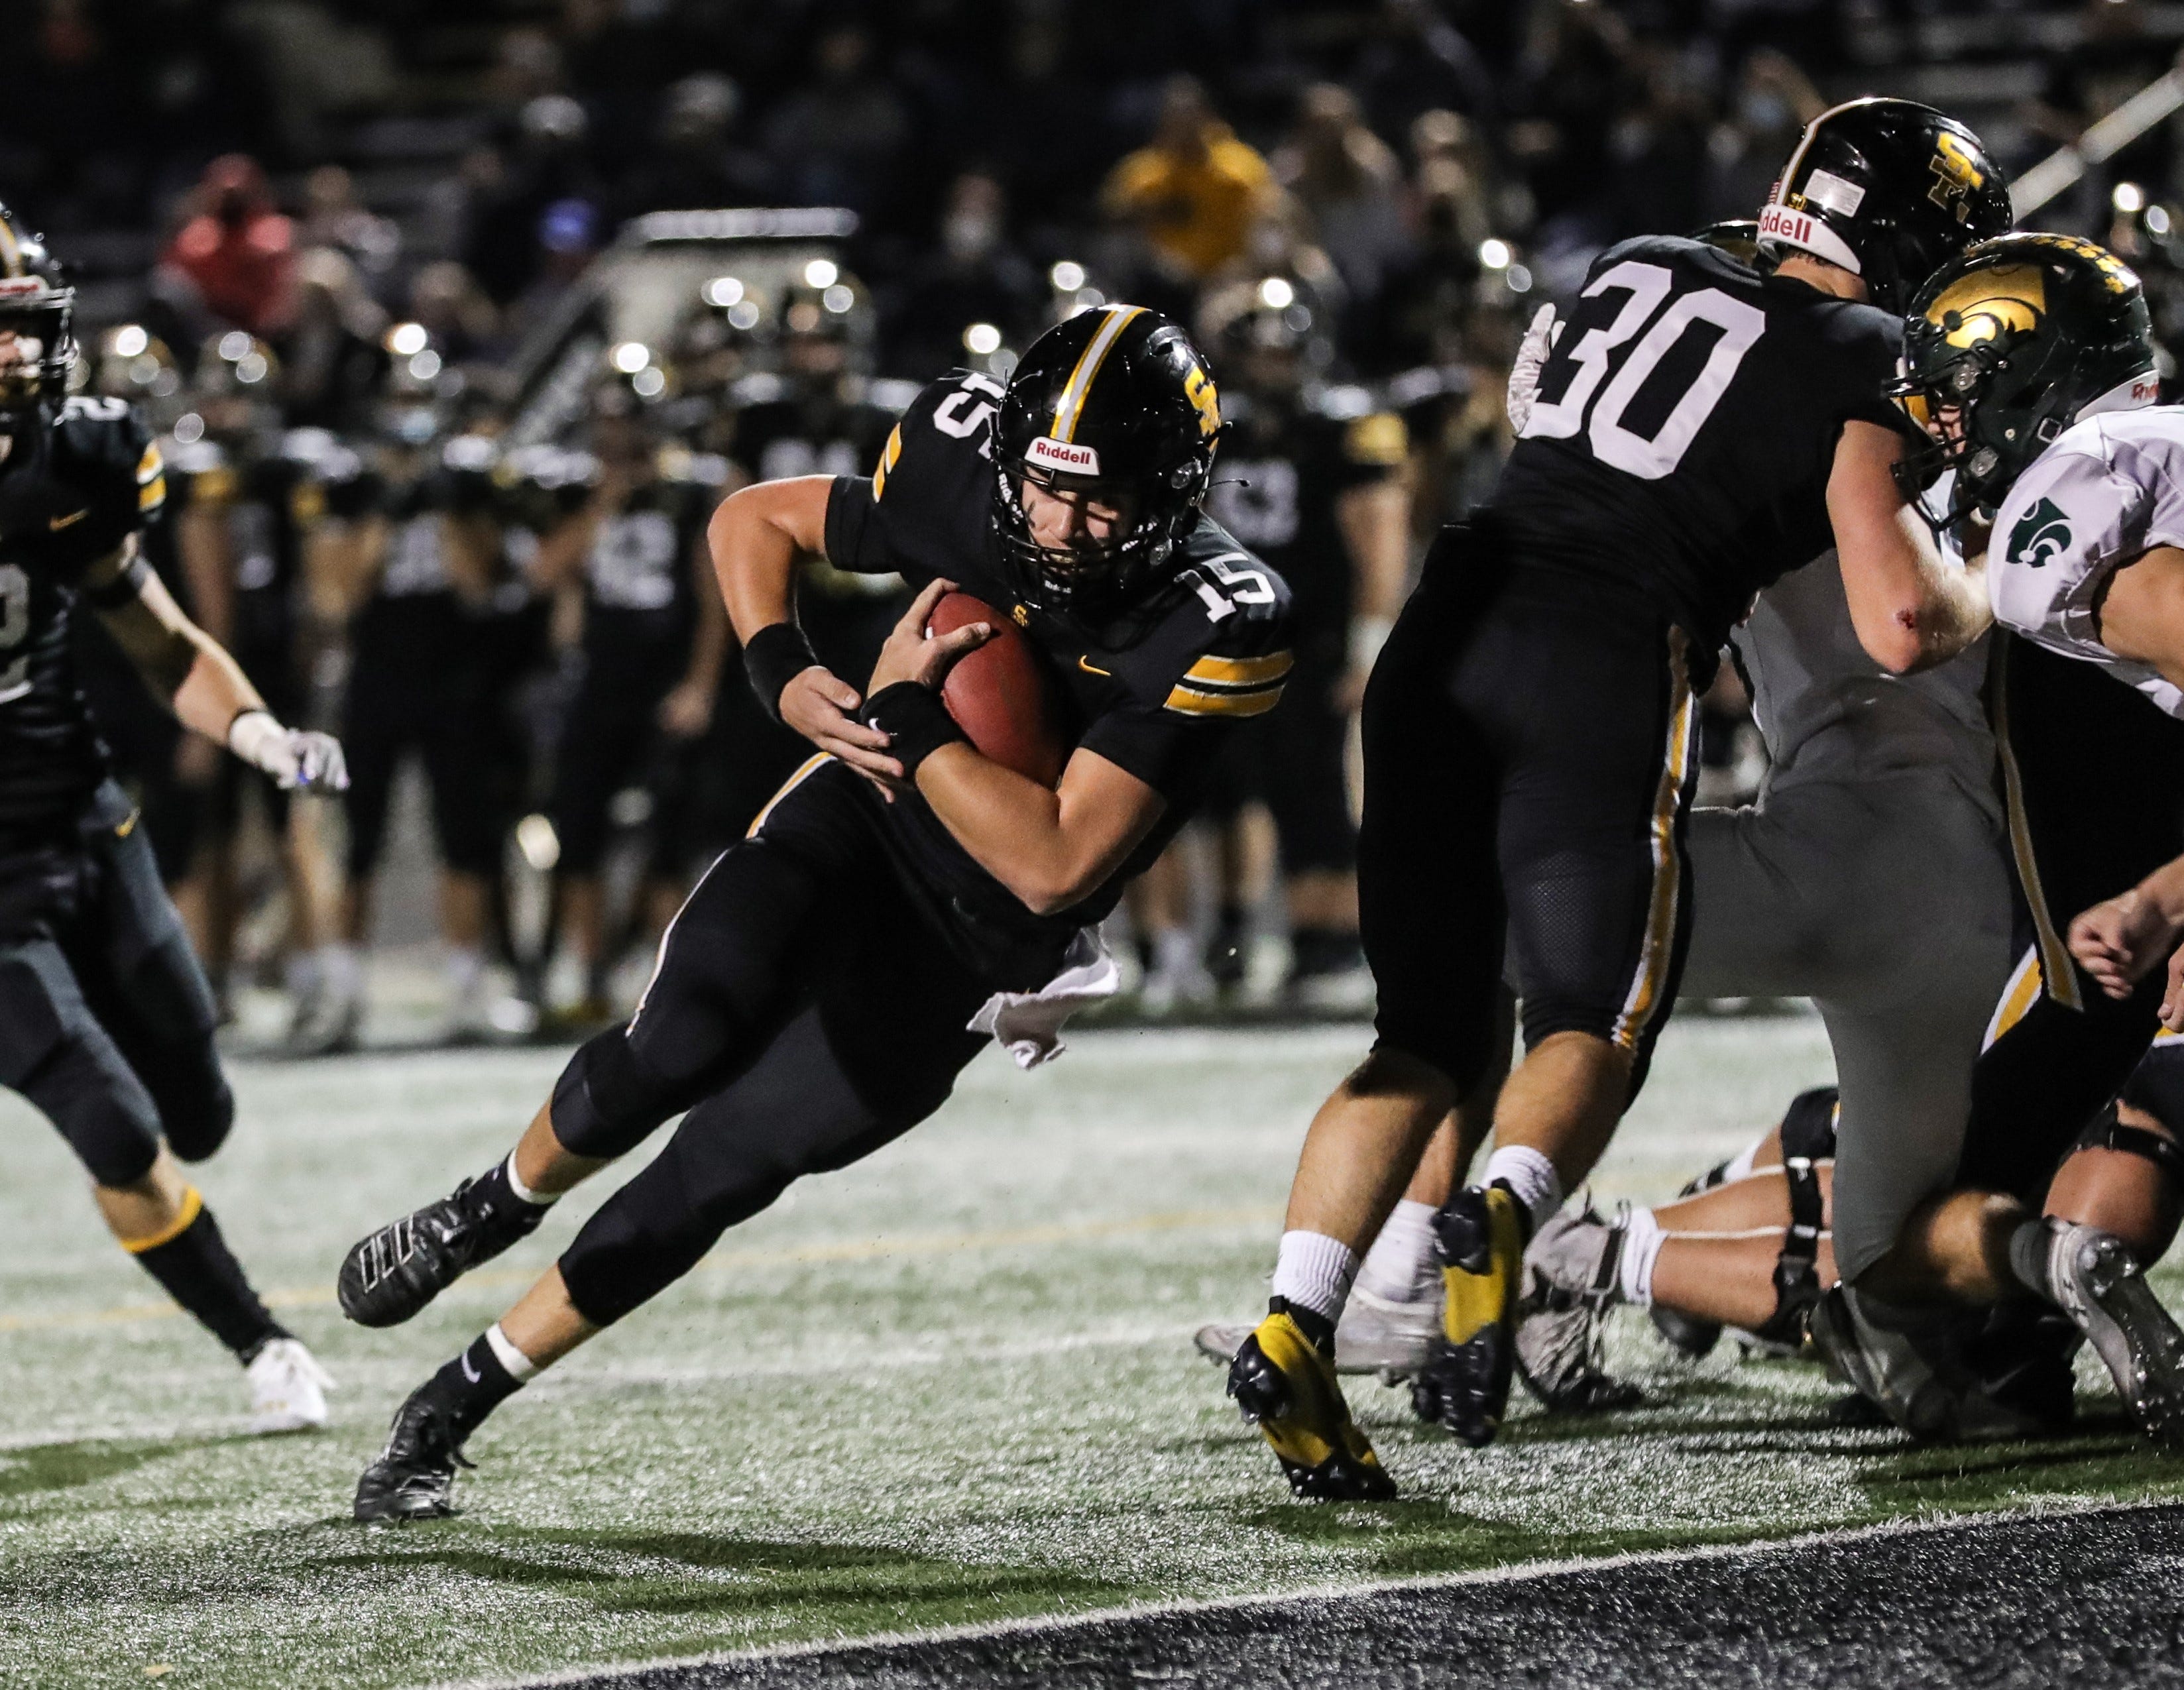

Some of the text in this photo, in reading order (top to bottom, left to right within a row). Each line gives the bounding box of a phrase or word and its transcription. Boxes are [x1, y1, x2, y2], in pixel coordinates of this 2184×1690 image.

[1760, 210, 1813, 244] ddell
[1518, 260, 1766, 480] 30
[1035, 441, 1092, 465] Riddell
[1173, 552, 1276, 624] 15
